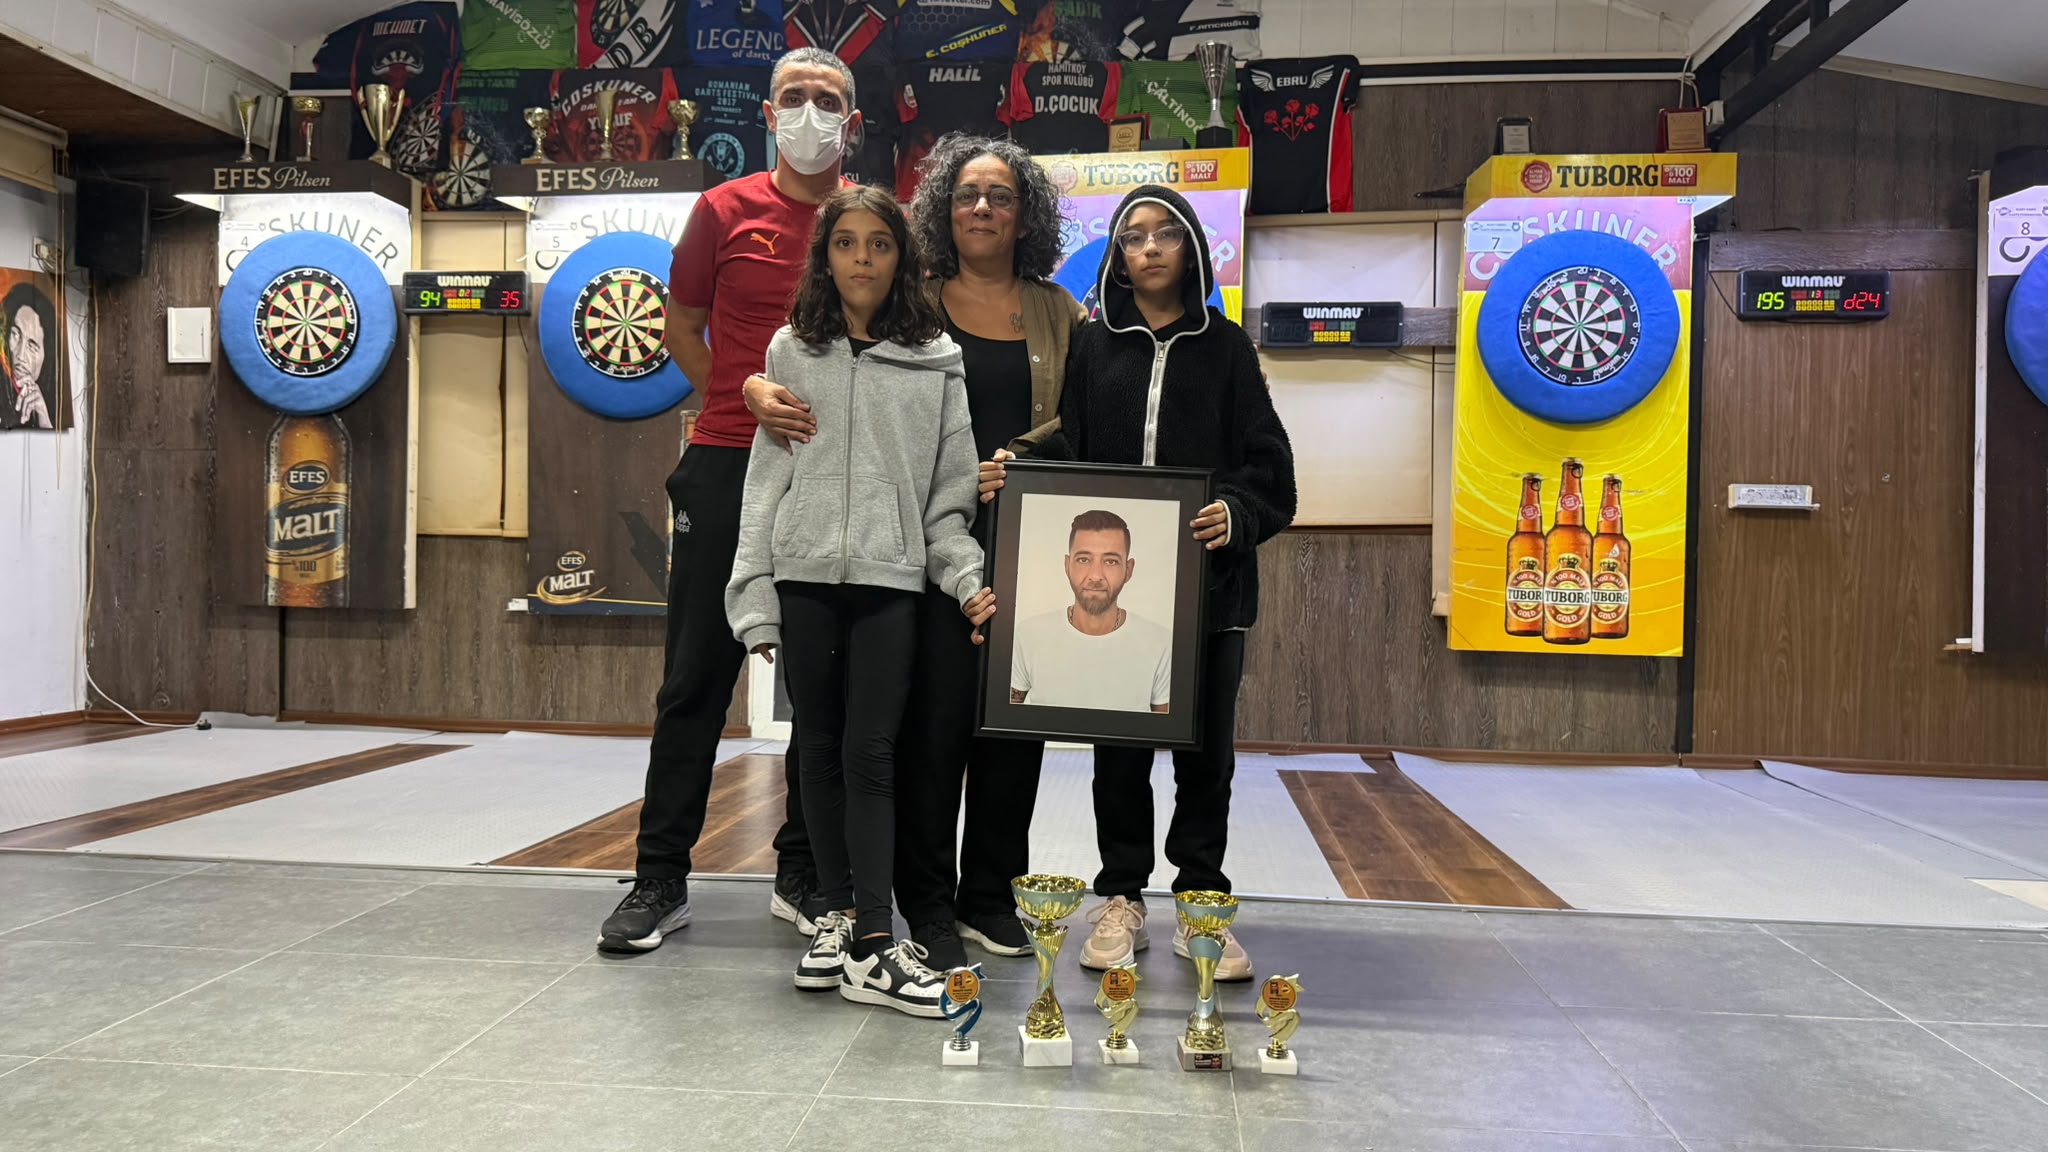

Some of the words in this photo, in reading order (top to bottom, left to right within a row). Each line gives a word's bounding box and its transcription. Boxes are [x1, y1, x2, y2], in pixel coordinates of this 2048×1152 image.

[732, 50, 743, 59] of
[745, 50, 770, 61] darts
[928, 64, 982, 82] HALİL
[708, 80, 751, 91] ROMANIAN
[1041, 75, 1062, 86] SPOR
[1276, 75, 1308, 88] EBRU
[695, 88, 721, 96] DARTS
[722, 88, 761, 102] FESTIVAL
[1035, 95, 1099, 115] D.ÇOCUK
[213, 166, 271, 190] EFES
[273, 166, 332, 190] Pilsen
[535, 167, 598, 192] EFES
[599, 166, 660, 191] Pilsen
[1083, 160, 1180, 187] TUBORG
[1556, 164, 1659, 188] TUBORG
[1668, 177, 1691, 185] MALT
[2020, 222, 2031, 236] 8
[240, 235, 249, 247] 4
[552, 236, 561, 248] 5
[1491, 236, 1501, 250] 7
[437, 275, 491, 287] WINMAU
[1781, 275, 1843, 288] WINMAU
[420, 290, 441, 308] 94
[500, 290, 520, 308] 35
[1756, 291, 1785, 310] 195
[1303, 307, 1362, 319] WINMAU
[289, 470, 326, 484] EFES
[561, 556, 583, 565] EFES
[1570, 573, 1586, 587] MALT
[1608, 576, 1624, 588] MALT
[1508, 589, 1542, 600] TUBOR
[1545, 591, 1590, 604] TUBORG
[1517, 610, 1537, 618] GOLD
[1556, 613, 1578, 622] GOLD
